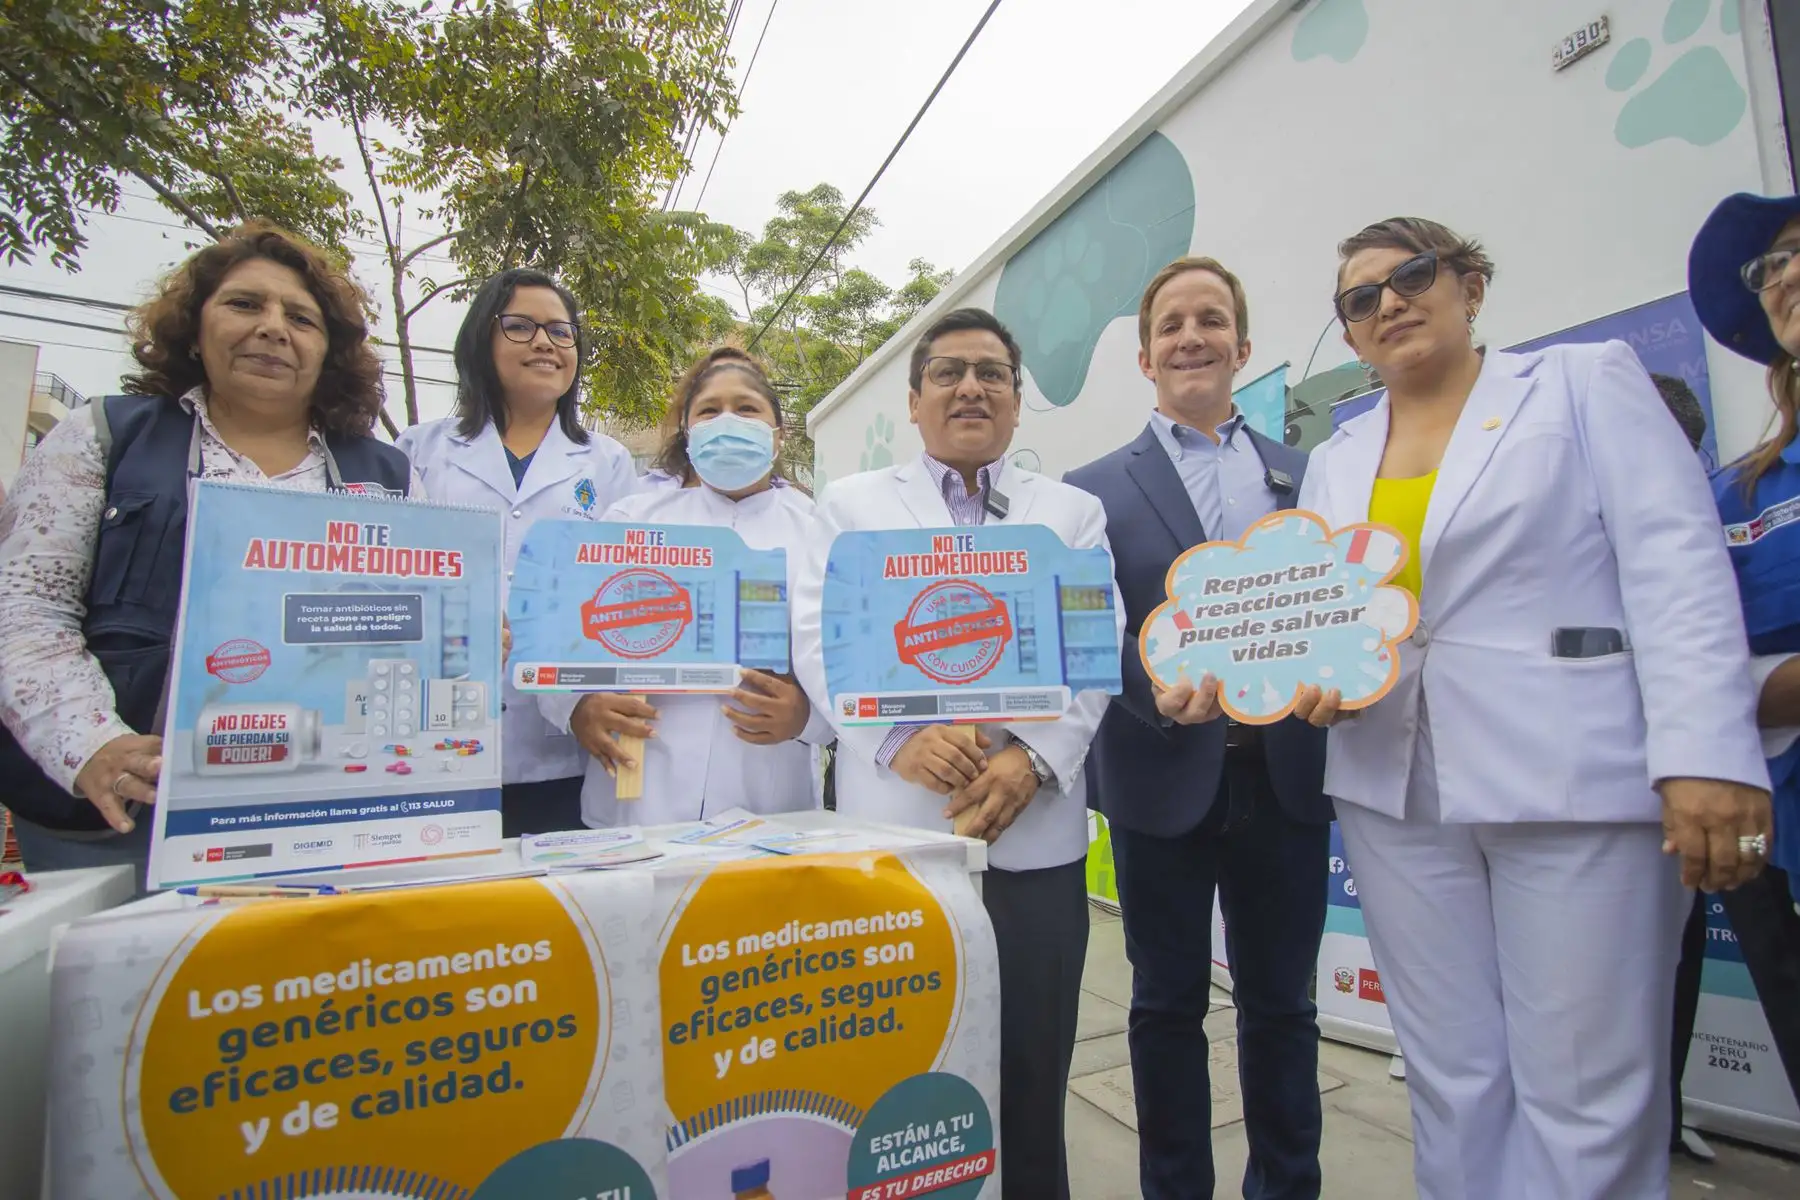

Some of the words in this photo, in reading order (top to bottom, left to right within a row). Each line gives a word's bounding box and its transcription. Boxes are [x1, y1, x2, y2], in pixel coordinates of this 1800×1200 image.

[328, 521, 359, 544] NO
[364, 524, 389, 546] TE
[626, 530, 645, 545] NO
[649, 530, 664, 546] TE
[933, 536, 953, 553] NO
[956, 535, 974, 552] TE
[244, 540, 462, 578] AUTOMEDIQUES
[577, 544, 713, 567] AUTOMEDIQUES
[884, 551, 1028, 578] AUTOMEDIQUES
[1203, 561, 1333, 596] Reportar
[301, 605, 332, 613] Tomar
[335, 604, 392, 613] antibióticos
[394, 604, 408, 612] sin
[1195, 584, 1344, 619] reacciones
[311, 624, 321, 632] la
[323, 624, 352, 632] salud
[371, 623, 402, 631] todos.
[331, 616, 358, 624] pone
[376, 613, 412, 623] peligro
[1179, 621, 1266, 648] puede
[1270, 604, 1366, 632] salvar
[927, 652, 948, 672] CON
[951, 640, 991, 673] CUIDADO
[1232, 640, 1309, 662] vidas
[207, 734, 227, 745] QUE
[229, 733, 274, 745] PIERDAN
[275, 732, 289, 743] SU
[212, 715, 238, 734] ¡NO
[241, 714, 286, 729] DEJES
[221, 746, 272, 762] PODER!
[211, 817, 236, 826] Para
[238, 814, 262, 824] más
[264, 809, 328, 822] información
[330, 807, 357, 817] llama
[359, 805, 387, 817] gratis
[390, 804, 399, 812] al
[408, 802, 421, 810] 113
[423, 800, 455, 809] SALUD
[293, 840, 333, 850] DIGEMID
[682, 941, 730, 967] Los
[736, 908, 923, 957] medicamentos
[188, 981, 263, 1020] Los
[274, 938, 552, 1003] medicamentos
[700, 947, 857, 1003] genéricos
[863, 940, 914, 966] son
[1362, 979, 1383, 992] PER
[218, 989, 454, 1063] genéricos
[465, 978, 538, 1012] son
[668, 992, 813, 1045] eficaces,
[820, 969, 942, 1008] seguros
[713, 1049, 733, 1079] y
[740, 1035, 777, 1066] de
[783, 1006, 903, 1052] calidad.
[168, 1047, 394, 1114] eficaces,
[404, 1013, 577, 1068] seguros
[1708, 1055, 1752, 1074] 2024
[240, 1114, 270, 1154] y
[281, 1100, 339, 1137] de
[350, 1060, 524, 1120] calidad.
[870, 1122, 930, 1154] ESTÁN
[934, 1120, 947, 1137] A
[950, 1112, 974, 1132] TU
[876, 1135, 965, 1174] ALCANCE,
[861, 1186, 881, 1200] ES
[886, 1179, 909, 1199] TU
[911, 1156, 988, 1192] DERECHO
